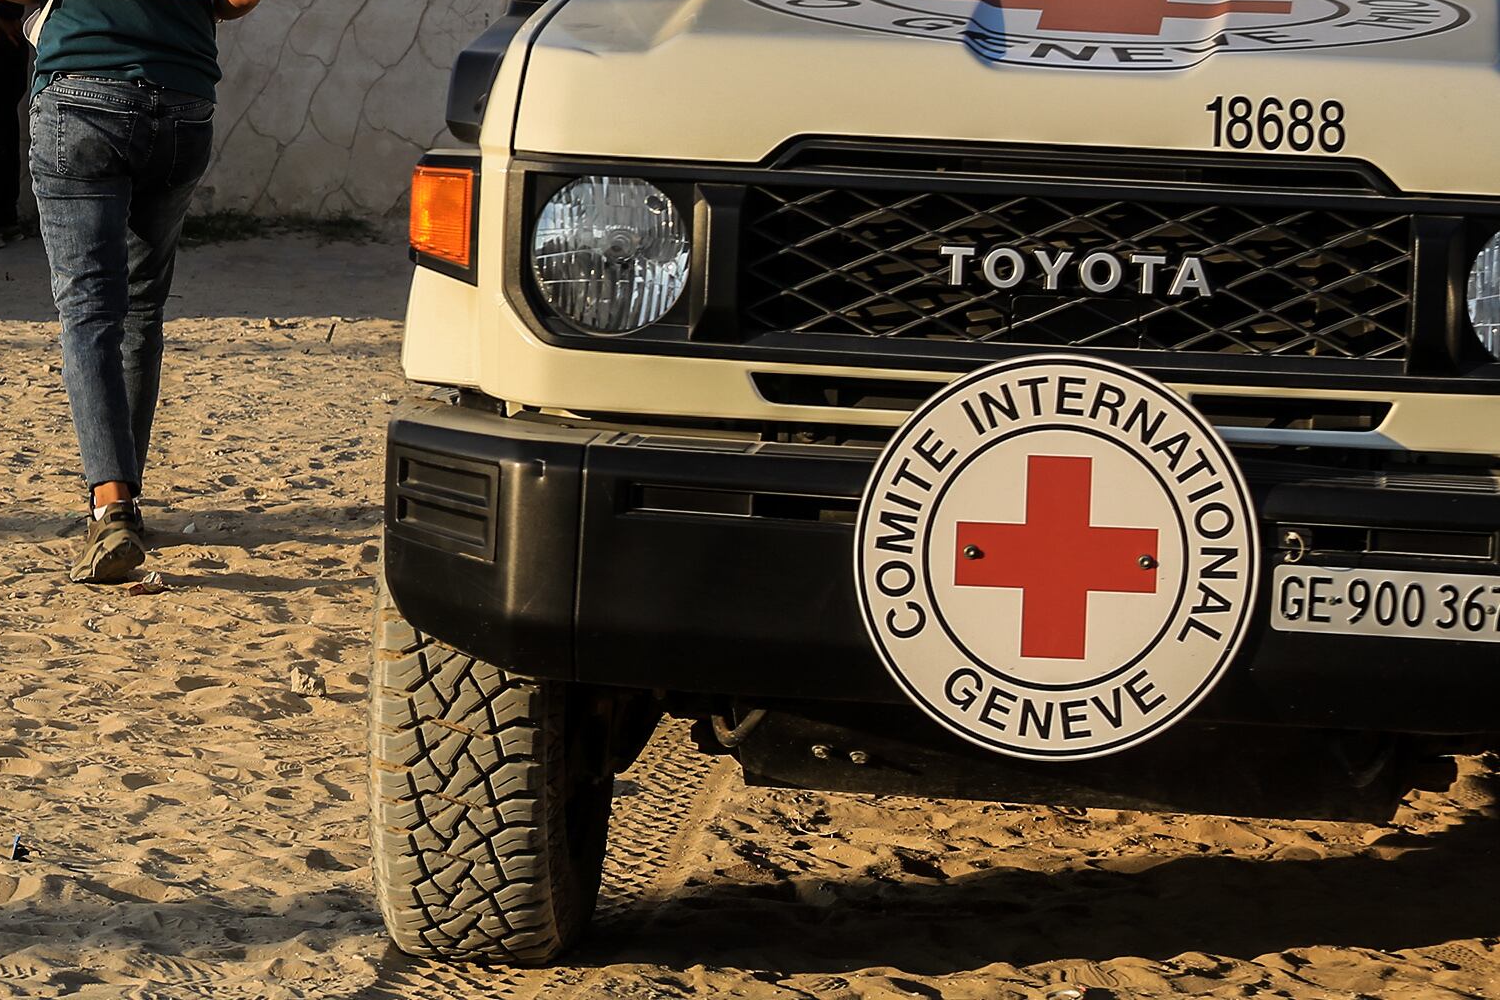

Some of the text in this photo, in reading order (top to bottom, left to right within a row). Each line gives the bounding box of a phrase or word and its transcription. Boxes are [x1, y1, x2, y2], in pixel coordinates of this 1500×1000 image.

[1206, 96, 1346, 153] 18688
[940, 245, 1212, 297] TOYOTA
[874, 376, 1239, 644] COMITE INTERNATIONAL
[944, 667, 1167, 740] GENEVE
